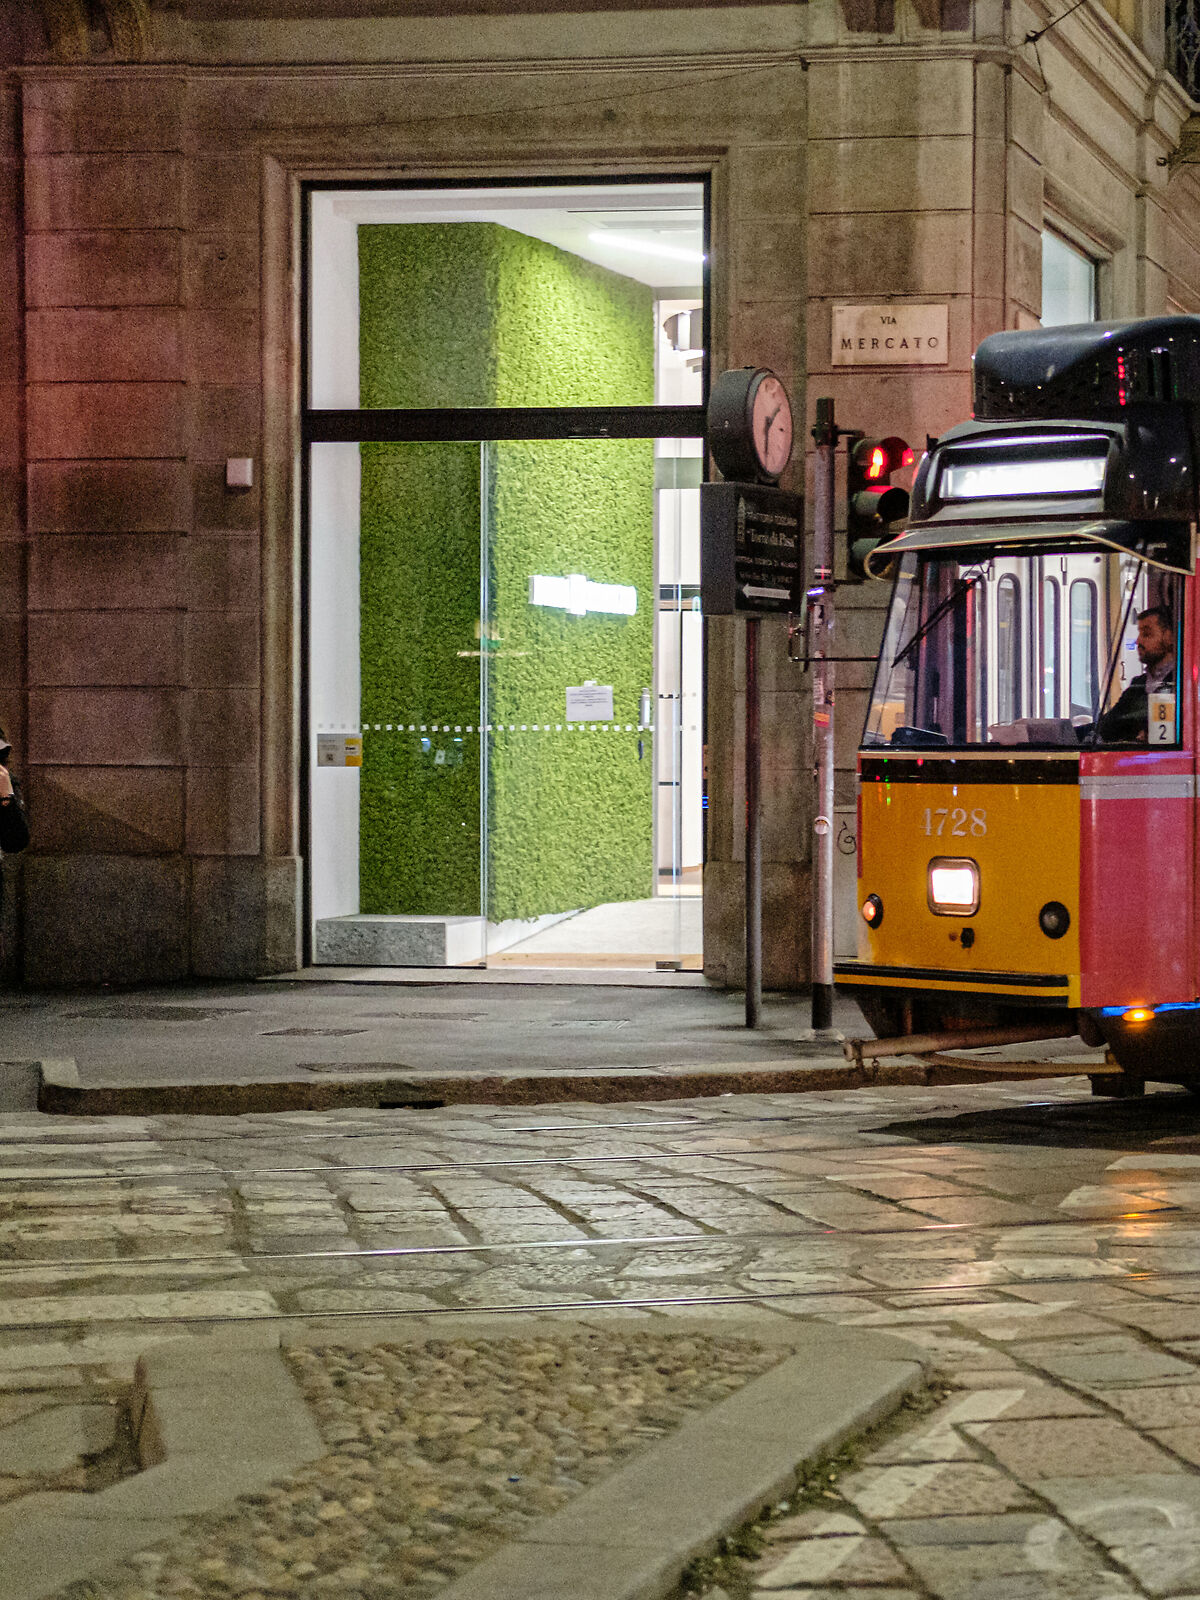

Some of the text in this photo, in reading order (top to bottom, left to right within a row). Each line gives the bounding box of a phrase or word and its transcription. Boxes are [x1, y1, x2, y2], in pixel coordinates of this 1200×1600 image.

[880, 316, 897, 325] VIA
[840, 337, 939, 350] MERCATO
[1158, 704, 1167, 721] 8
[1158, 724, 1167, 740] 2
[919, 807, 988, 837] 4728
